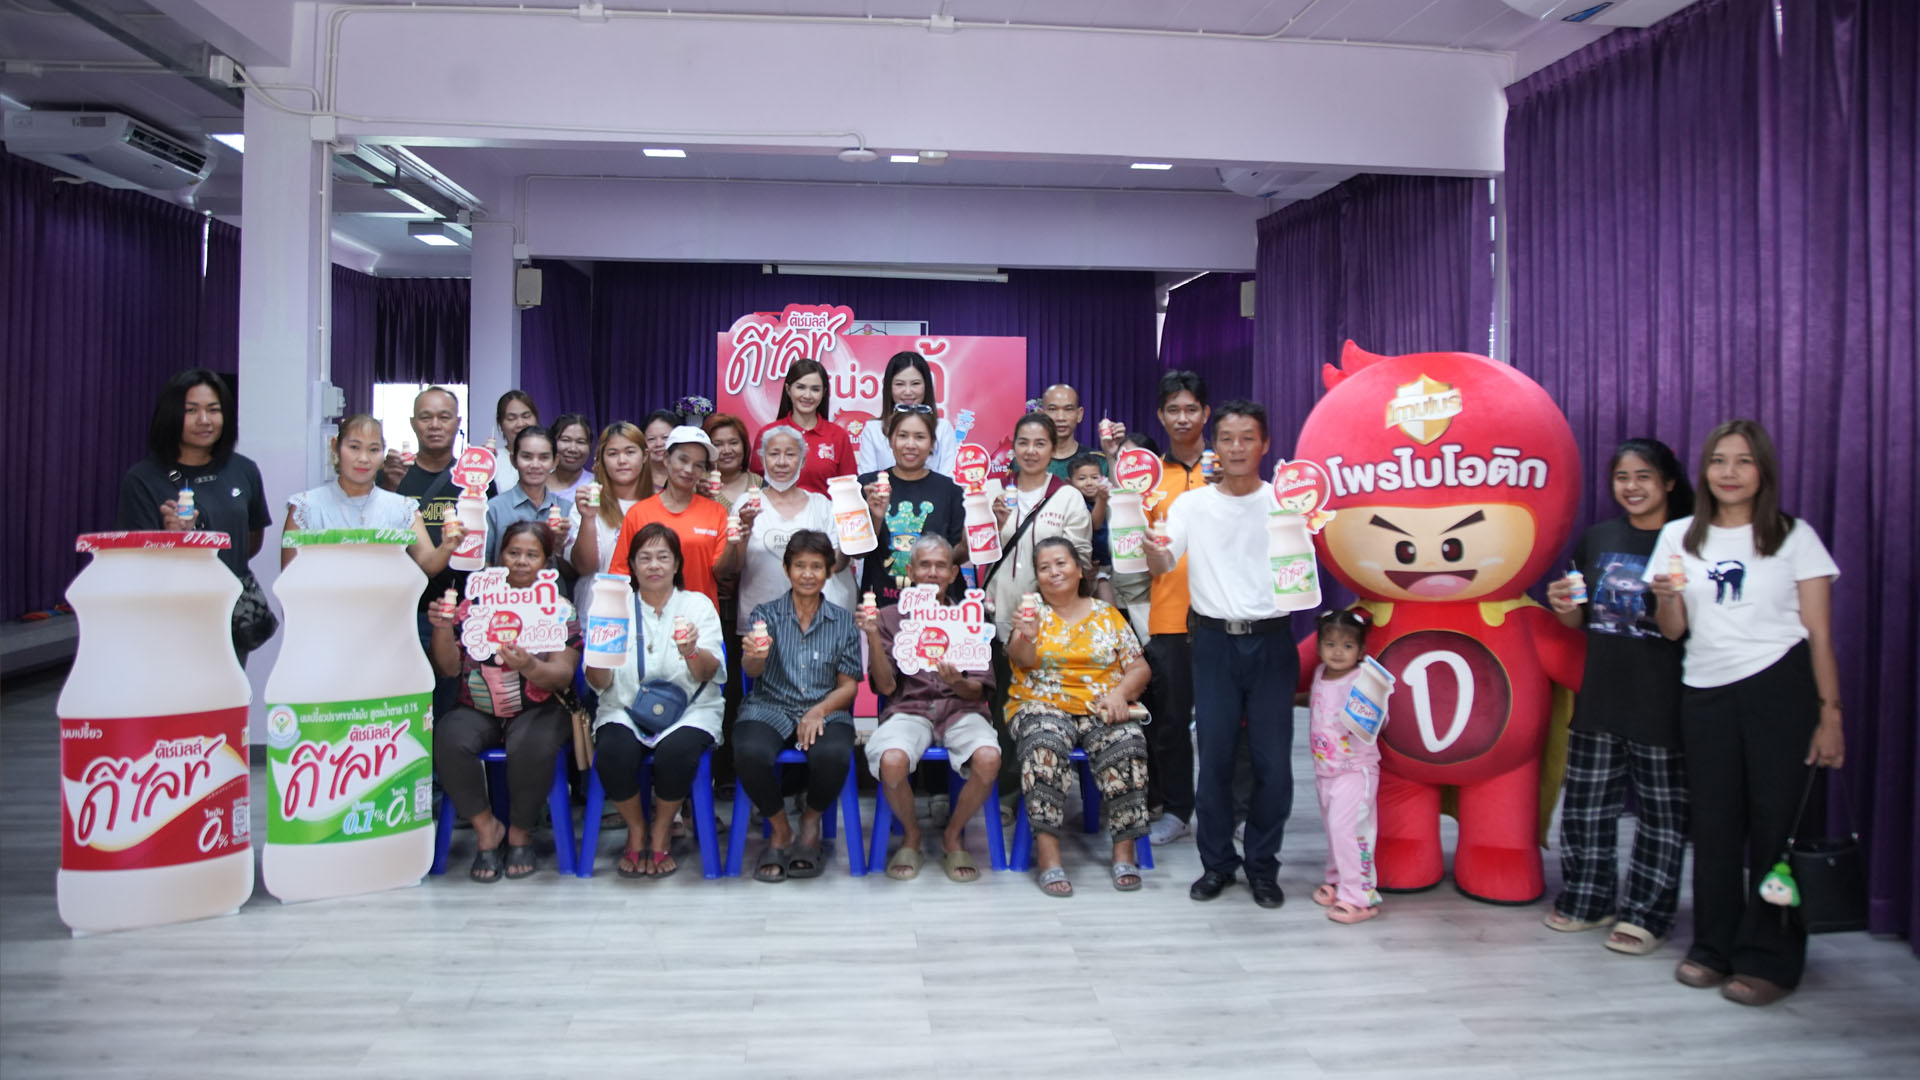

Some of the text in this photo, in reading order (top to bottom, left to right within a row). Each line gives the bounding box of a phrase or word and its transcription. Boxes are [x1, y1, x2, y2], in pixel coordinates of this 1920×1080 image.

[789, 313, 828, 328] ดัชมิลล์
[1325, 444, 1548, 497] โพรไบโอติก
[155, 738, 202, 759] ดัชมิลล์
[350, 722, 391, 742] ดัชมิลล์
[284, 723, 409, 818] ดีไลท์
[78, 739, 224, 842] ดีไลท์
